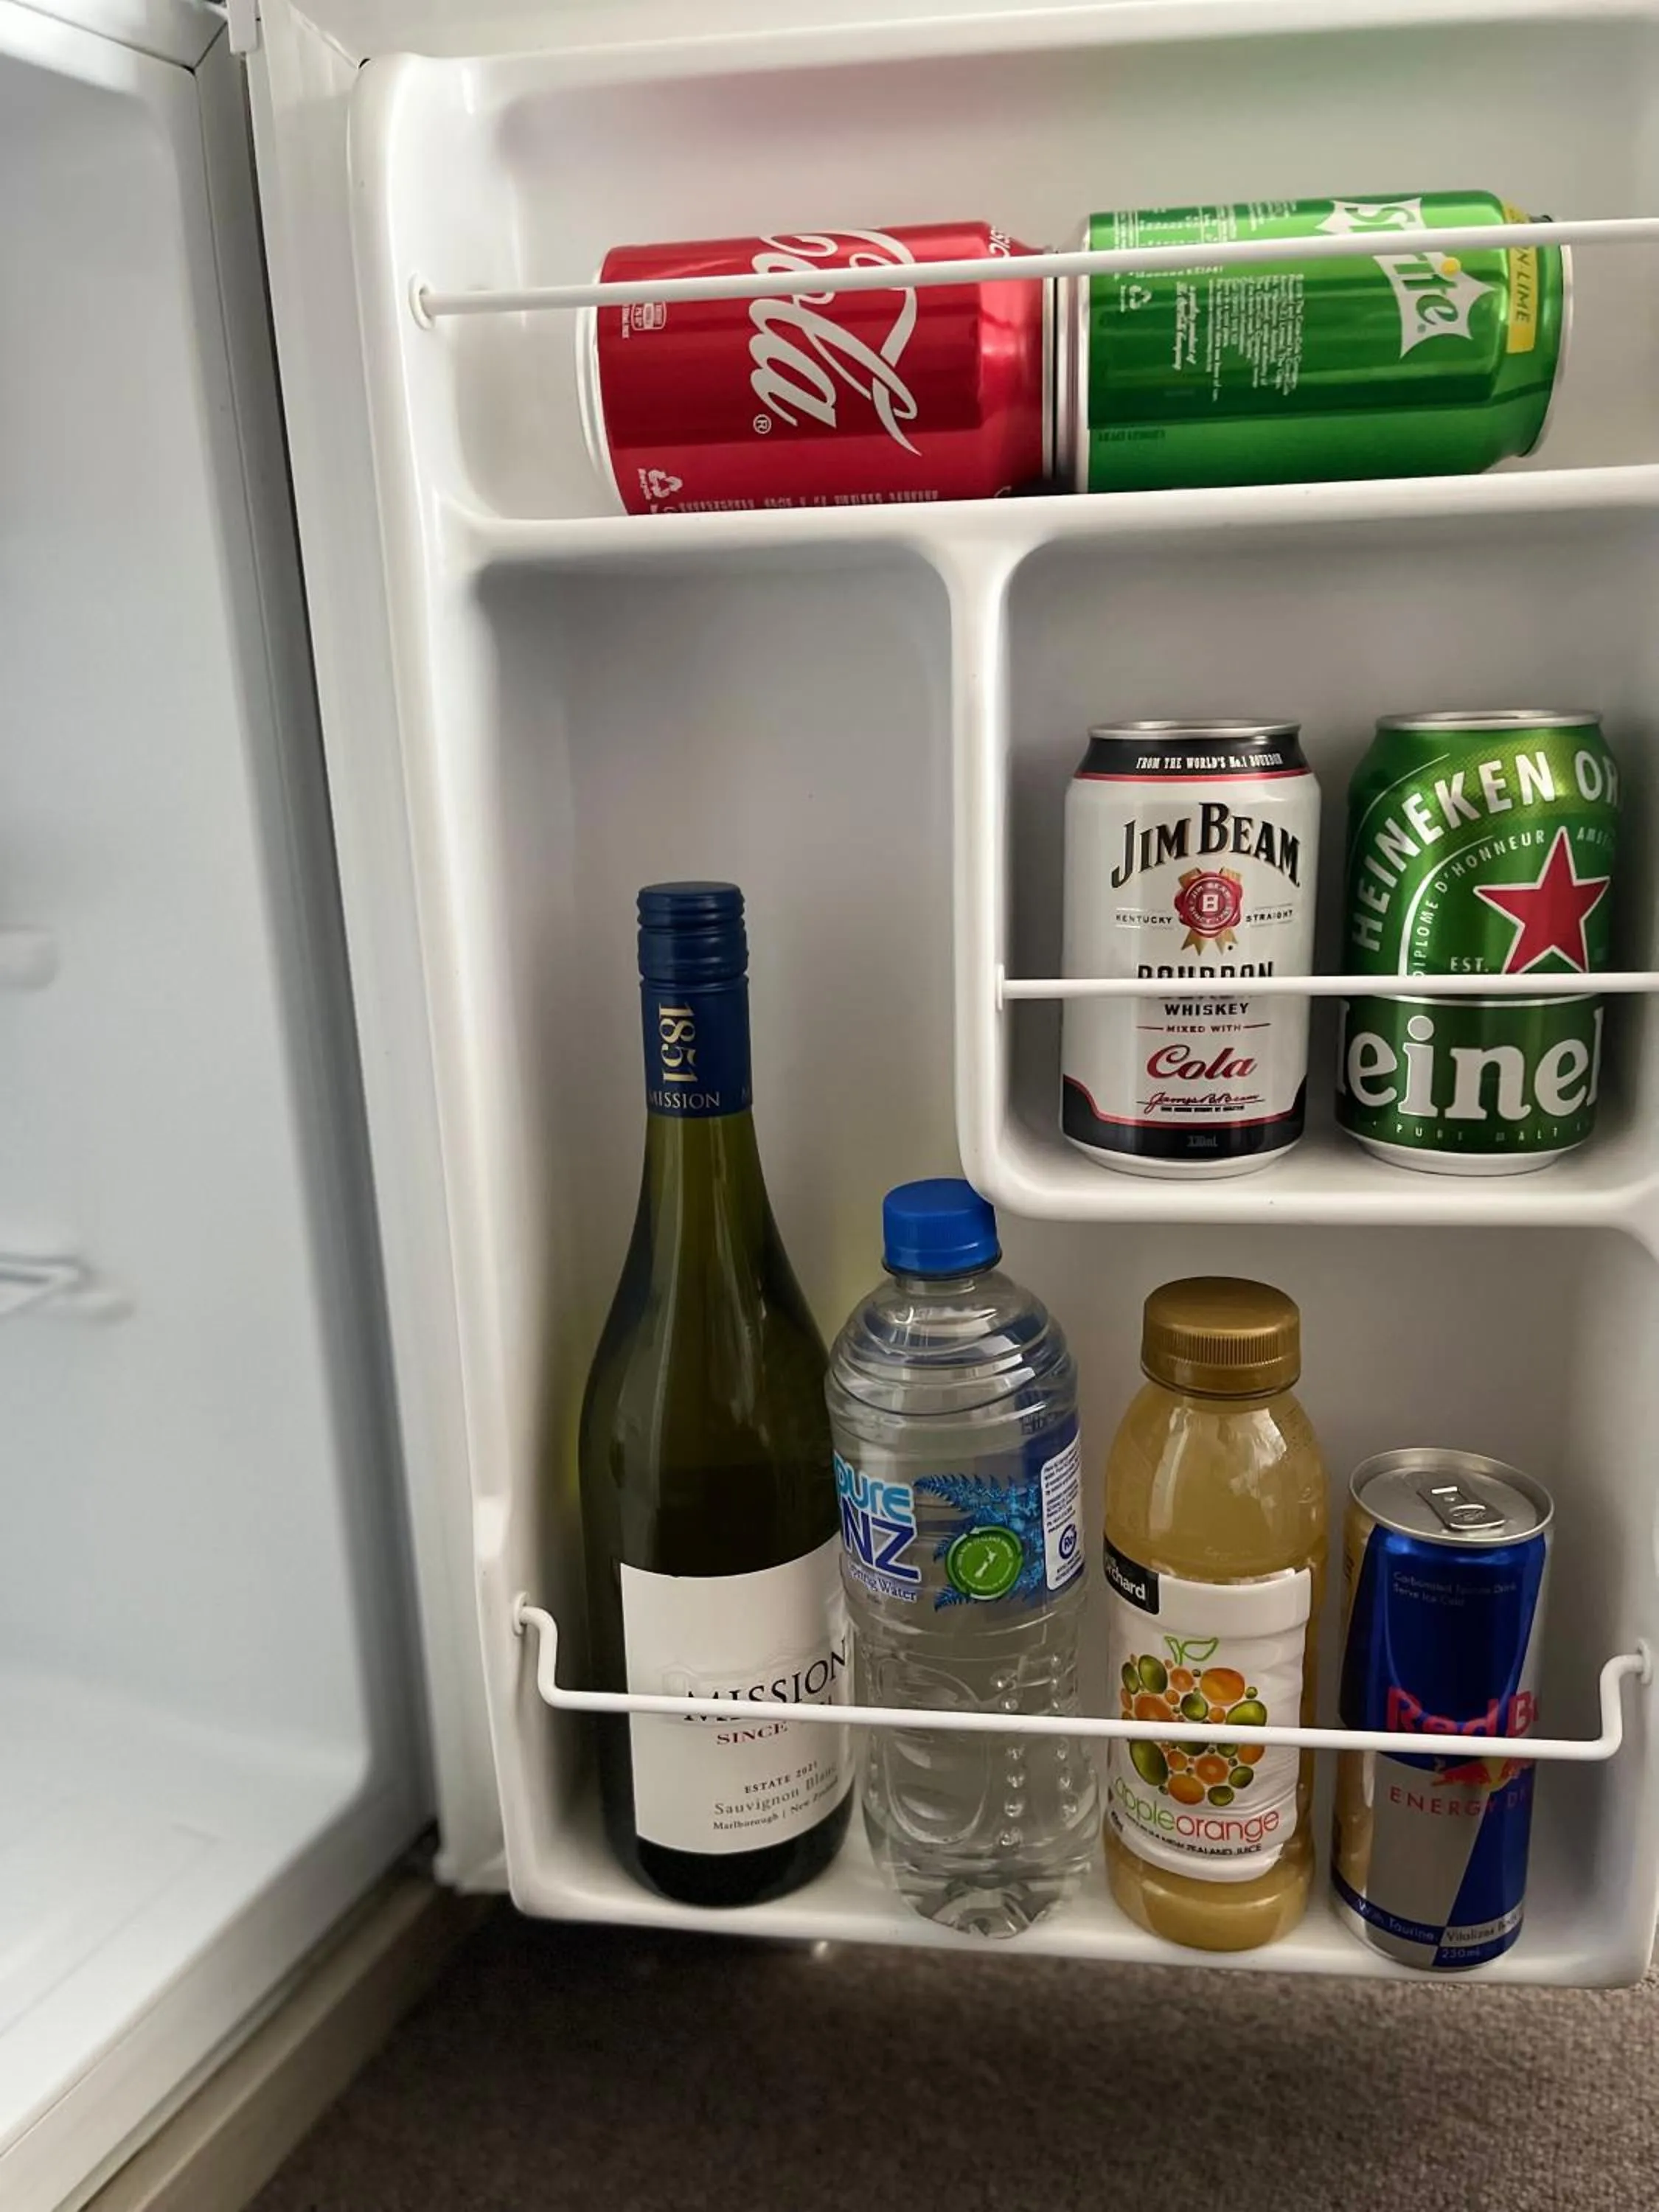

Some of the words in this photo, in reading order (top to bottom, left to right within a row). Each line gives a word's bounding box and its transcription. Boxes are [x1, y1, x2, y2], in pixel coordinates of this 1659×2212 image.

[1345, 206, 1461, 326] Site
[748, 228, 922, 456] Cola
[1135, 757, 1161, 769] FROM
[1164, 757, 1181, 769] THE
[1186, 756, 1225, 769] WORLD'S
[1110, 817, 1192, 888] JIM
[1197, 801, 1301, 888] BEAM
[1352, 750, 1555, 952] HEINEKEN
[1435, 830, 1545, 894] D'HONNEUR
[1116, 915, 1173, 925] KENTUCKY
[1245, 910, 1293, 922] STRAIGHT
[1450, 956, 1489, 973] EST.
[1165, 1002, 1250, 1016] WHISKEY
[1166, 1024, 1206, 1033] MIXED
[1211, 1023, 1242, 1032] WITH
[658, 1003, 698, 1083] 1851
[1147, 1044, 1258, 1081] Cola
[1338, 1001, 1603, 1121] eine
[841, 1496, 921, 1582] NZ
[878, 1577, 917, 1601] Water
[717, 1722, 788, 1745] SINCE
[744, 1775, 791, 1794] ESTATE
[714, 1788, 799, 1815] Sauvignon
[713, 1813, 779, 1830] Marlborough
[1236, 1843, 1262, 1854] JUICE
